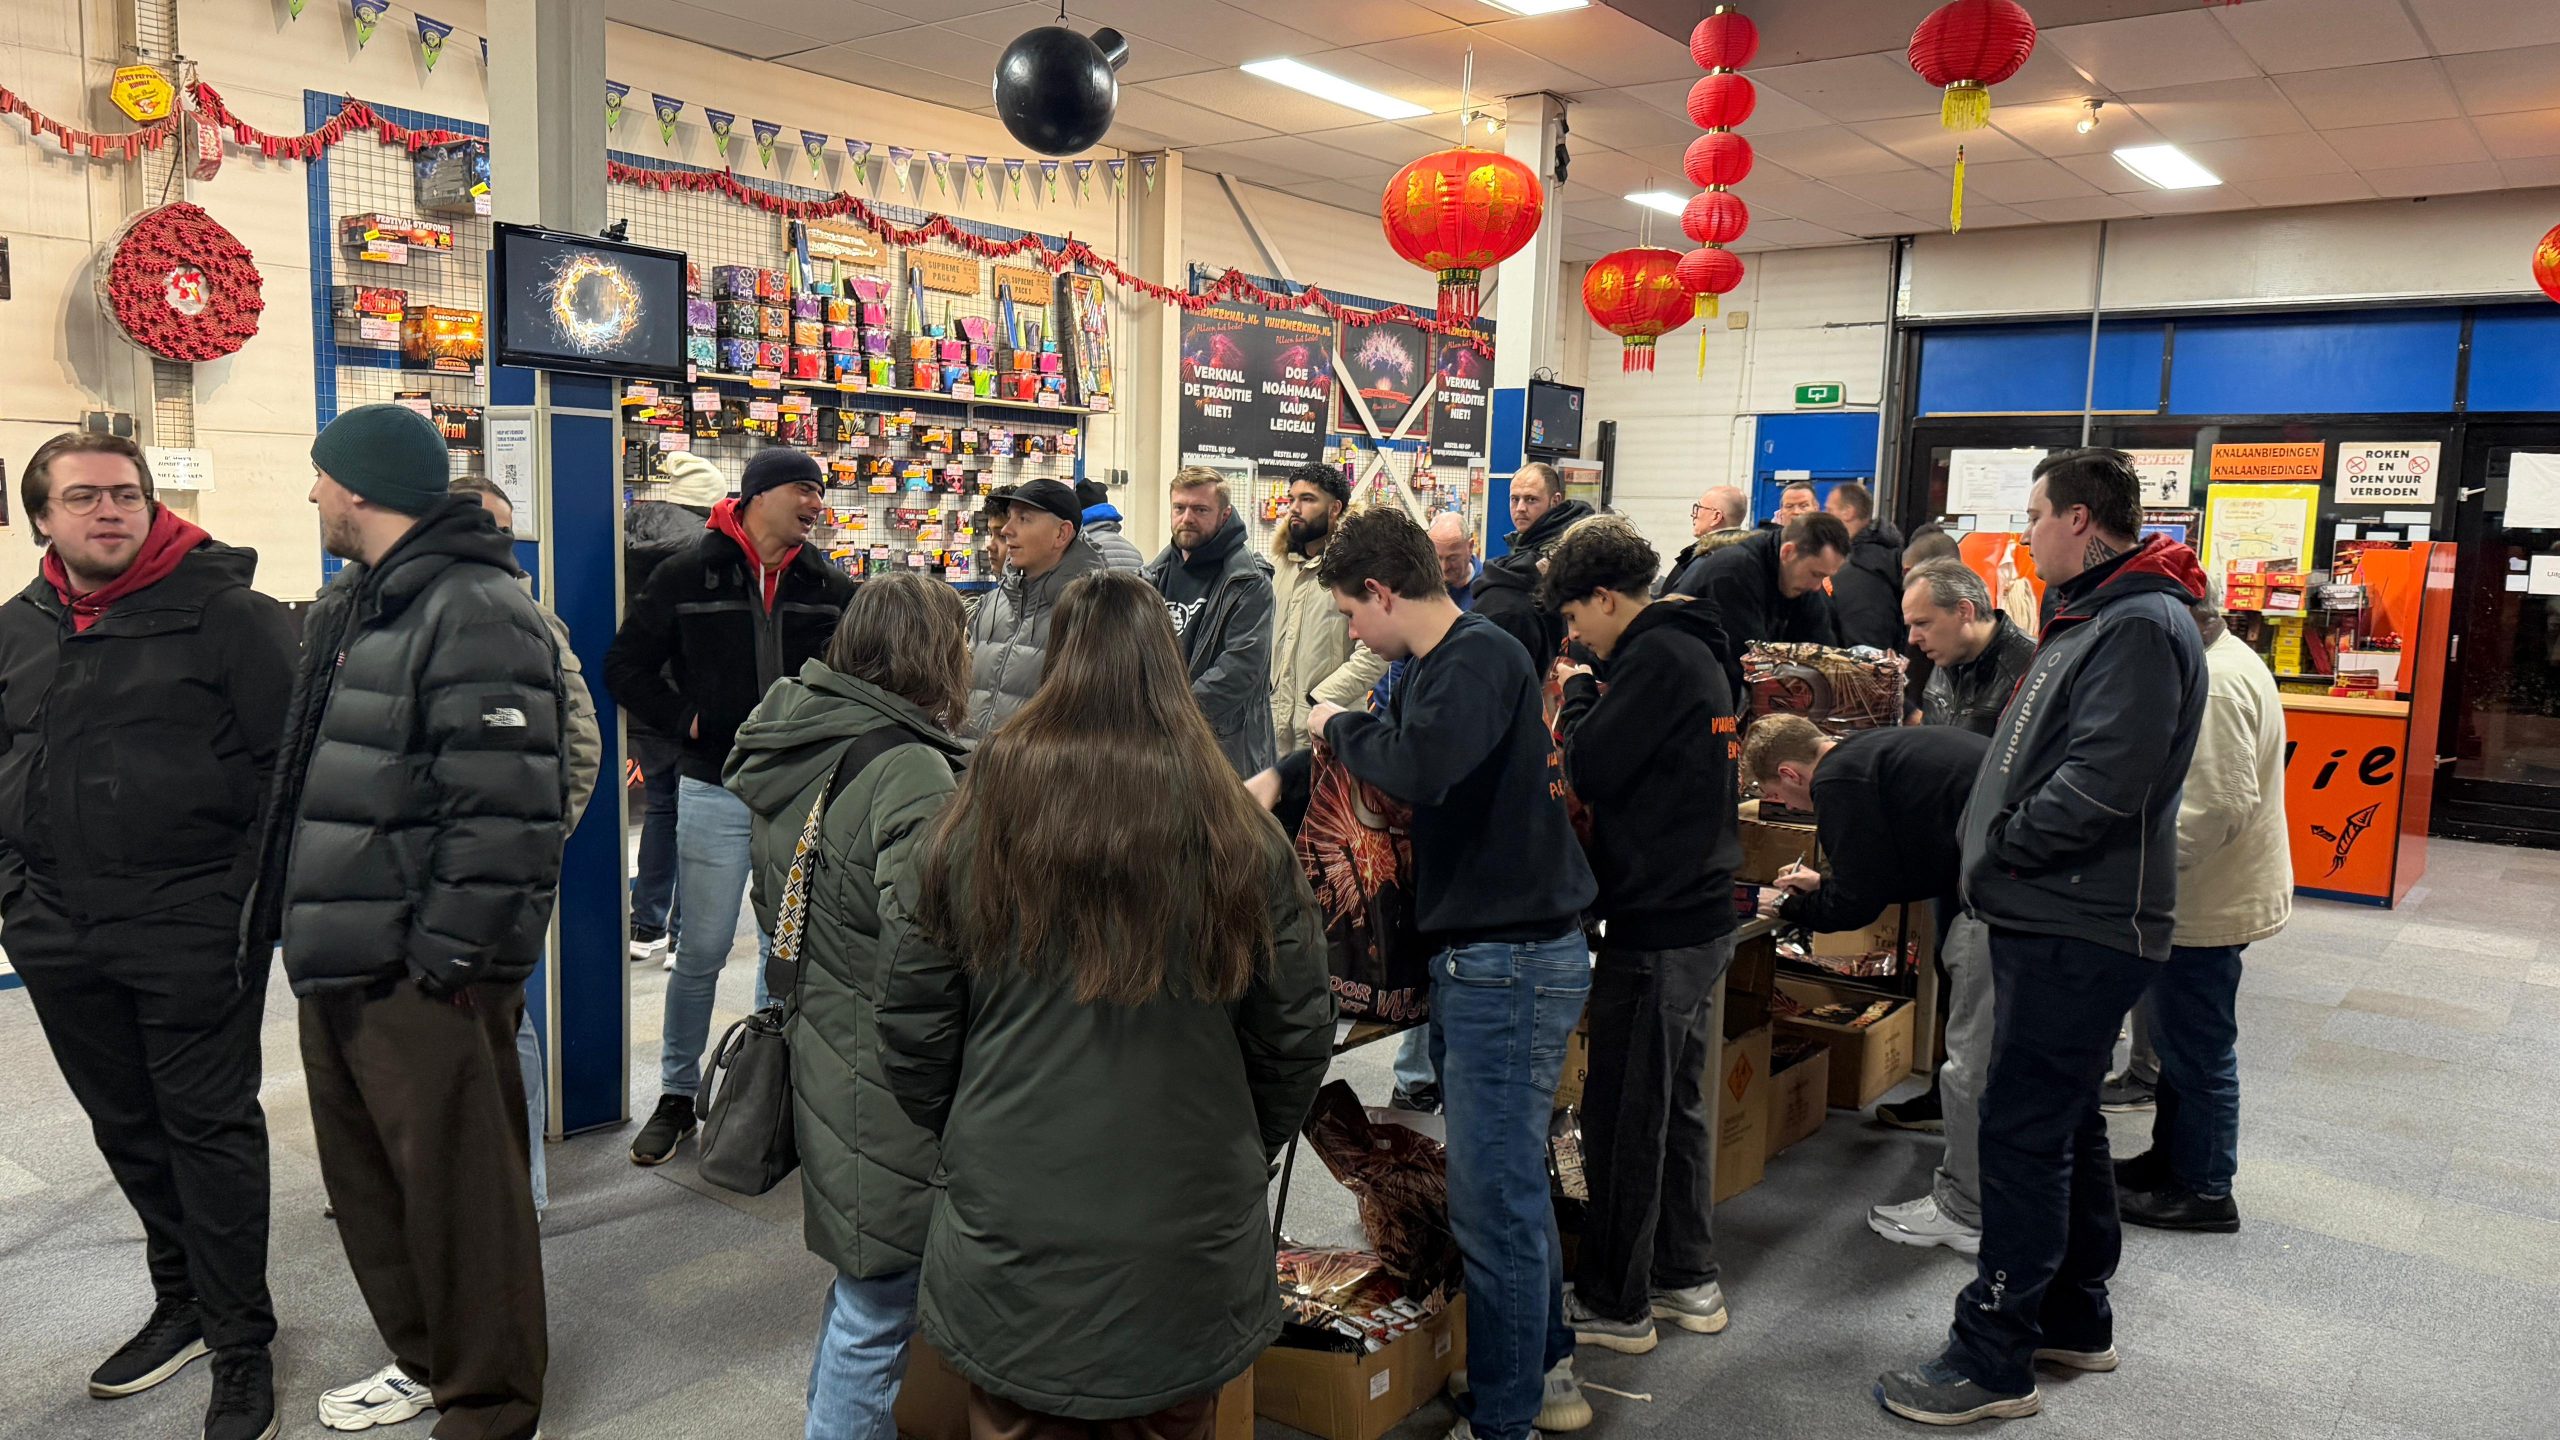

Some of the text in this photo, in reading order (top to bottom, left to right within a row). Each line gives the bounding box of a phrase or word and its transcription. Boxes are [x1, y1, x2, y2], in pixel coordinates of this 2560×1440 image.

[376, 214, 412, 229] FESTIVAL
[413, 221, 451, 234] SYMFONIE
[928, 261, 960, 273] SUPREME
[1011, 276, 1034, 287] SUPREME
[433, 314, 474, 323] SHOOTER
[738, 325, 754, 335] NA
[1265, 316, 1332, 337] VUURWERKHAL.NL
[768, 329, 783, 338] MA
[1193, 365, 1245, 383] VERKNAL
[1285, 366, 1308, 380] DOE
[1445, 376, 1481, 391] VERKNAL
[1185, 382, 1252, 403] DE TRADITIE
[1262, 380, 1327, 403] NOÂHMAAL,
[1437, 391, 1485, 406] DE TRADITIE
[1204, 403, 1232, 419] NIET!
[1280, 401, 1309, 415] KAUP
[1450, 408, 1471, 421] NIET!
[1198, 444, 1218, 453] BESTEL
[1227, 446, 1236, 454] OP
[1273, 450, 1292, 459] BESTEL
[1300, 452, 1308, 460] OP
[2215, 447, 2320, 459] KNALAANBIEDINGEN
[2366, 449, 2410, 459] ROKEN
[2132, 453, 2185, 466] RWERK
[2214, 465, 2318, 476] KNALAANBIEDINGEN
[2378, 462, 2394, 471] EN
[2350, 474, 2422, 484] OPEN VUUR
[2350, 487, 2418, 496] VERBODEN
[2000, 672, 2048, 774] medipoint
